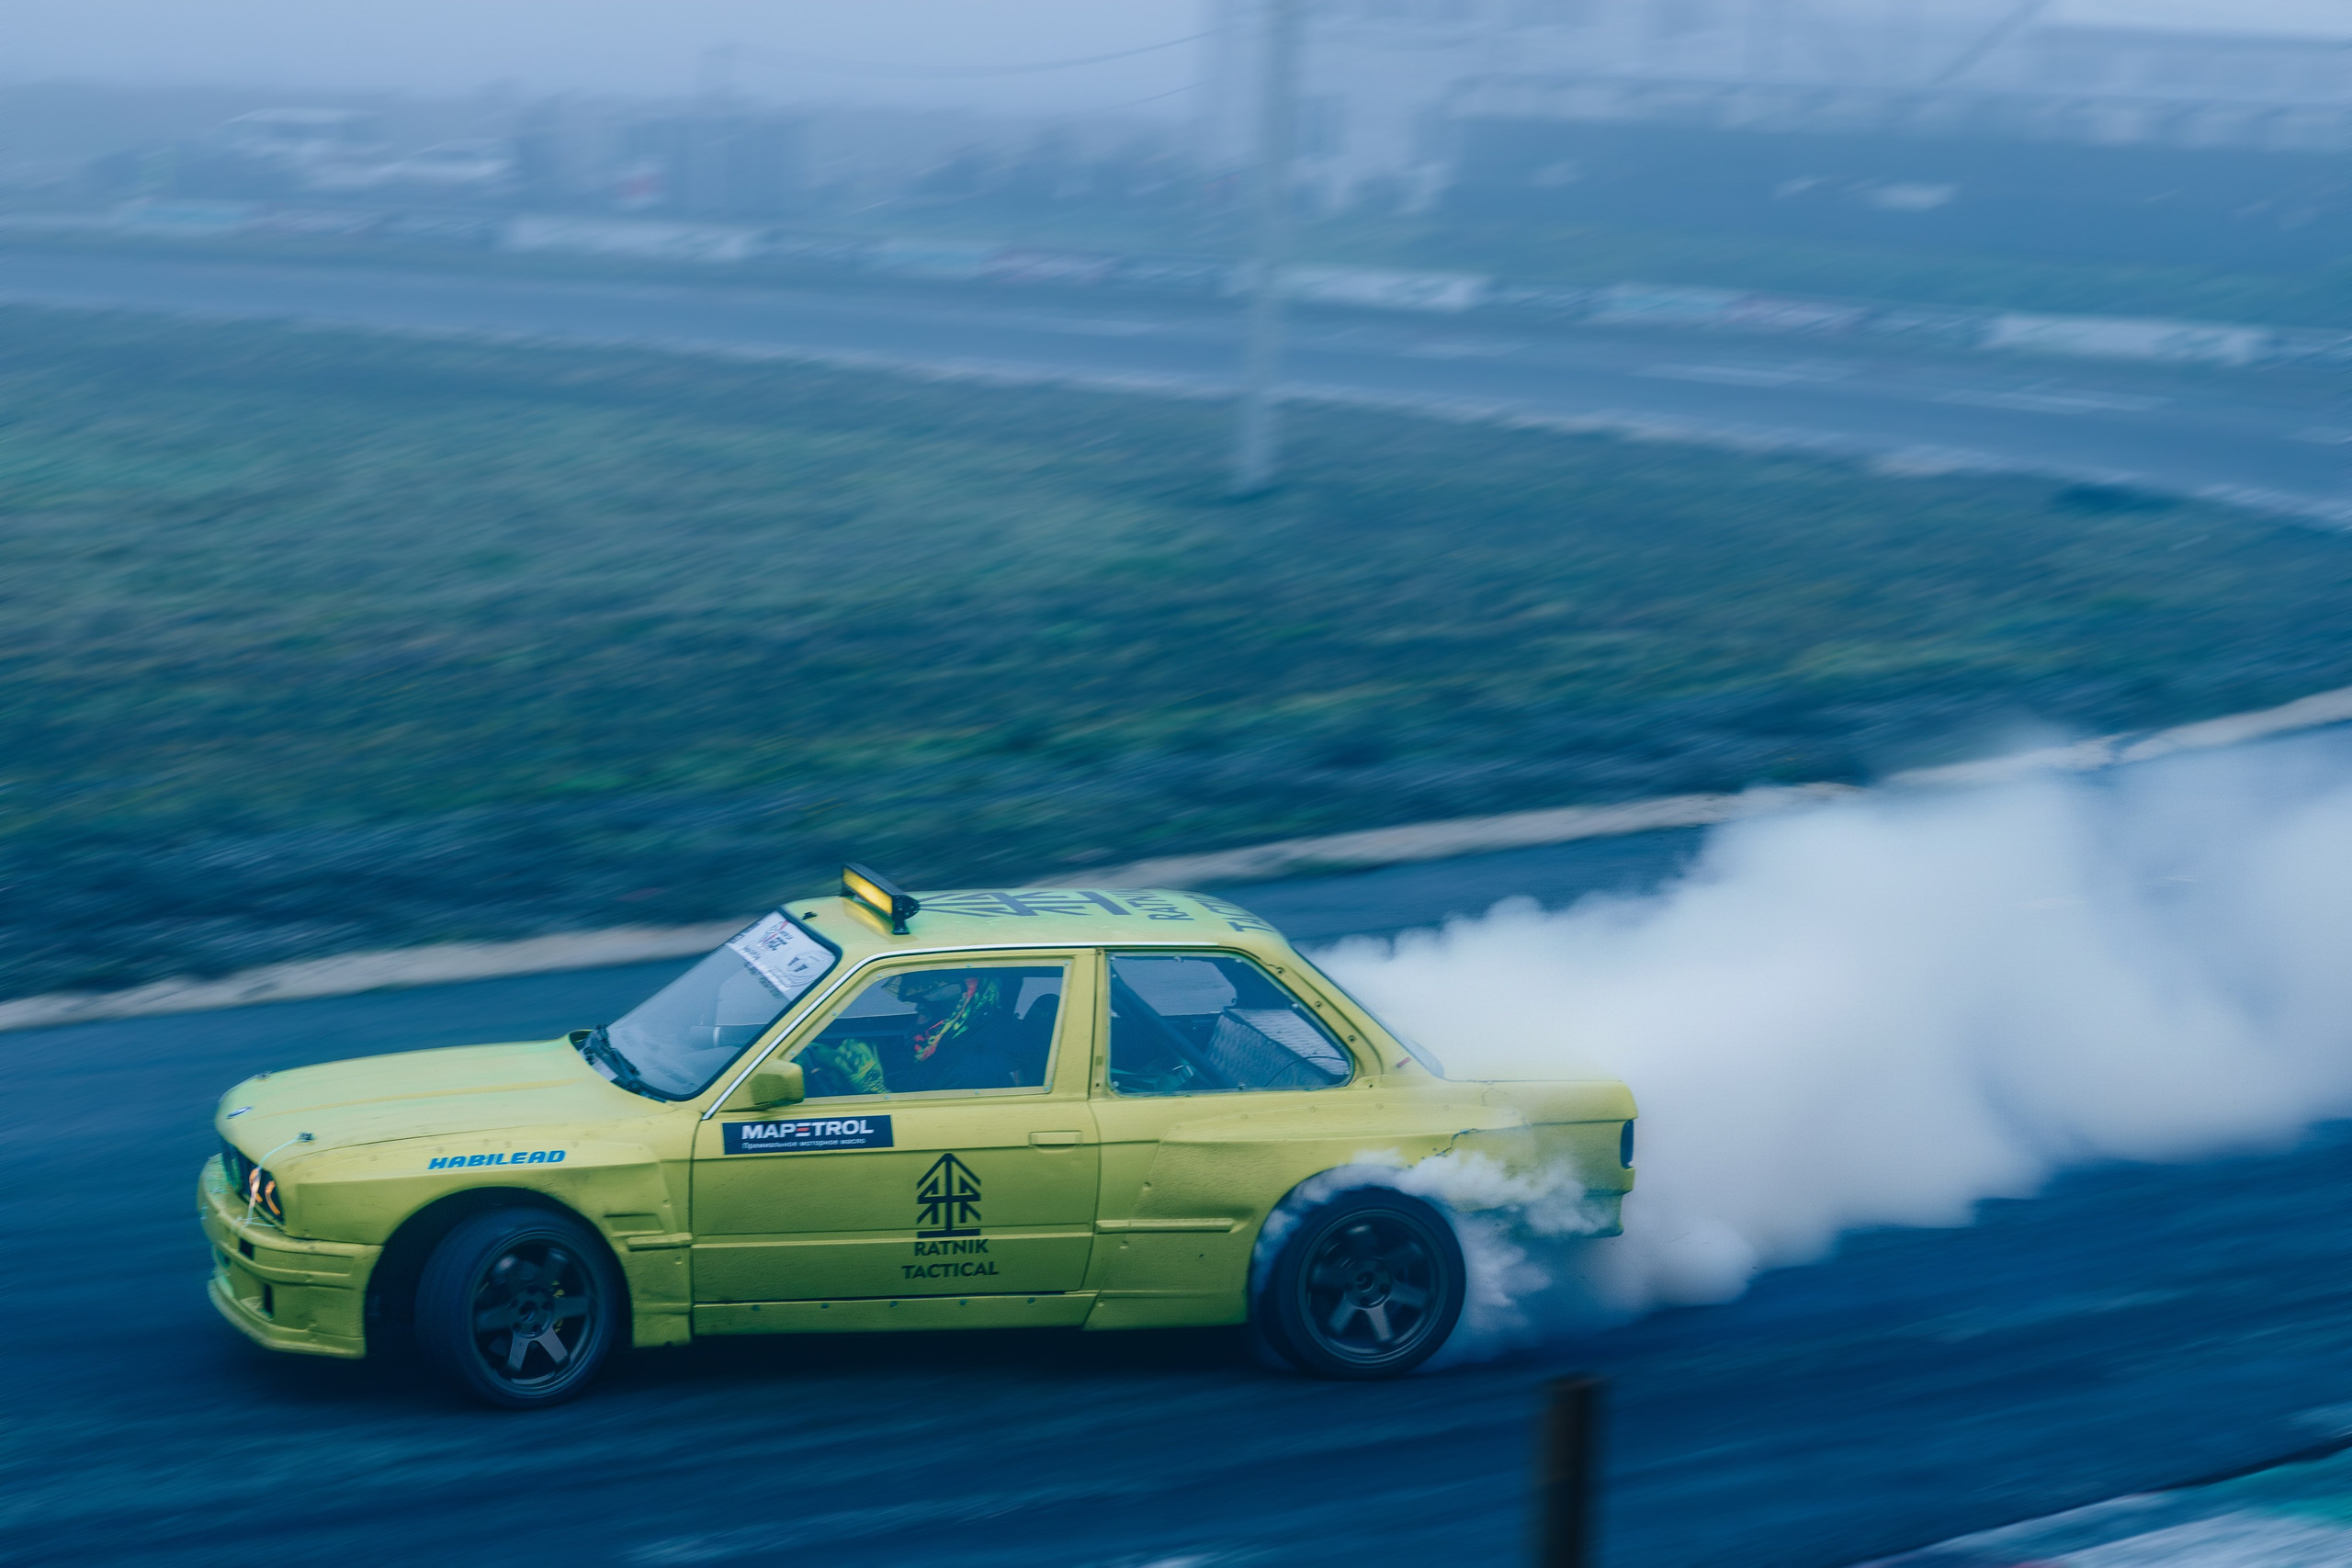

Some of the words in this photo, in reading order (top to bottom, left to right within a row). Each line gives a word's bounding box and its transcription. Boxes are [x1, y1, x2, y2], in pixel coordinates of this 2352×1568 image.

[1105, 887, 1195, 920] RATNIK
[1182, 892, 1275, 932] TACTIC
[741, 1120, 874, 1139] MAPETROL
[427, 1150, 566, 1169] HABILEAD
[914, 1239, 989, 1257] RATNIK
[901, 1261, 1000, 1280] TACTICAL
